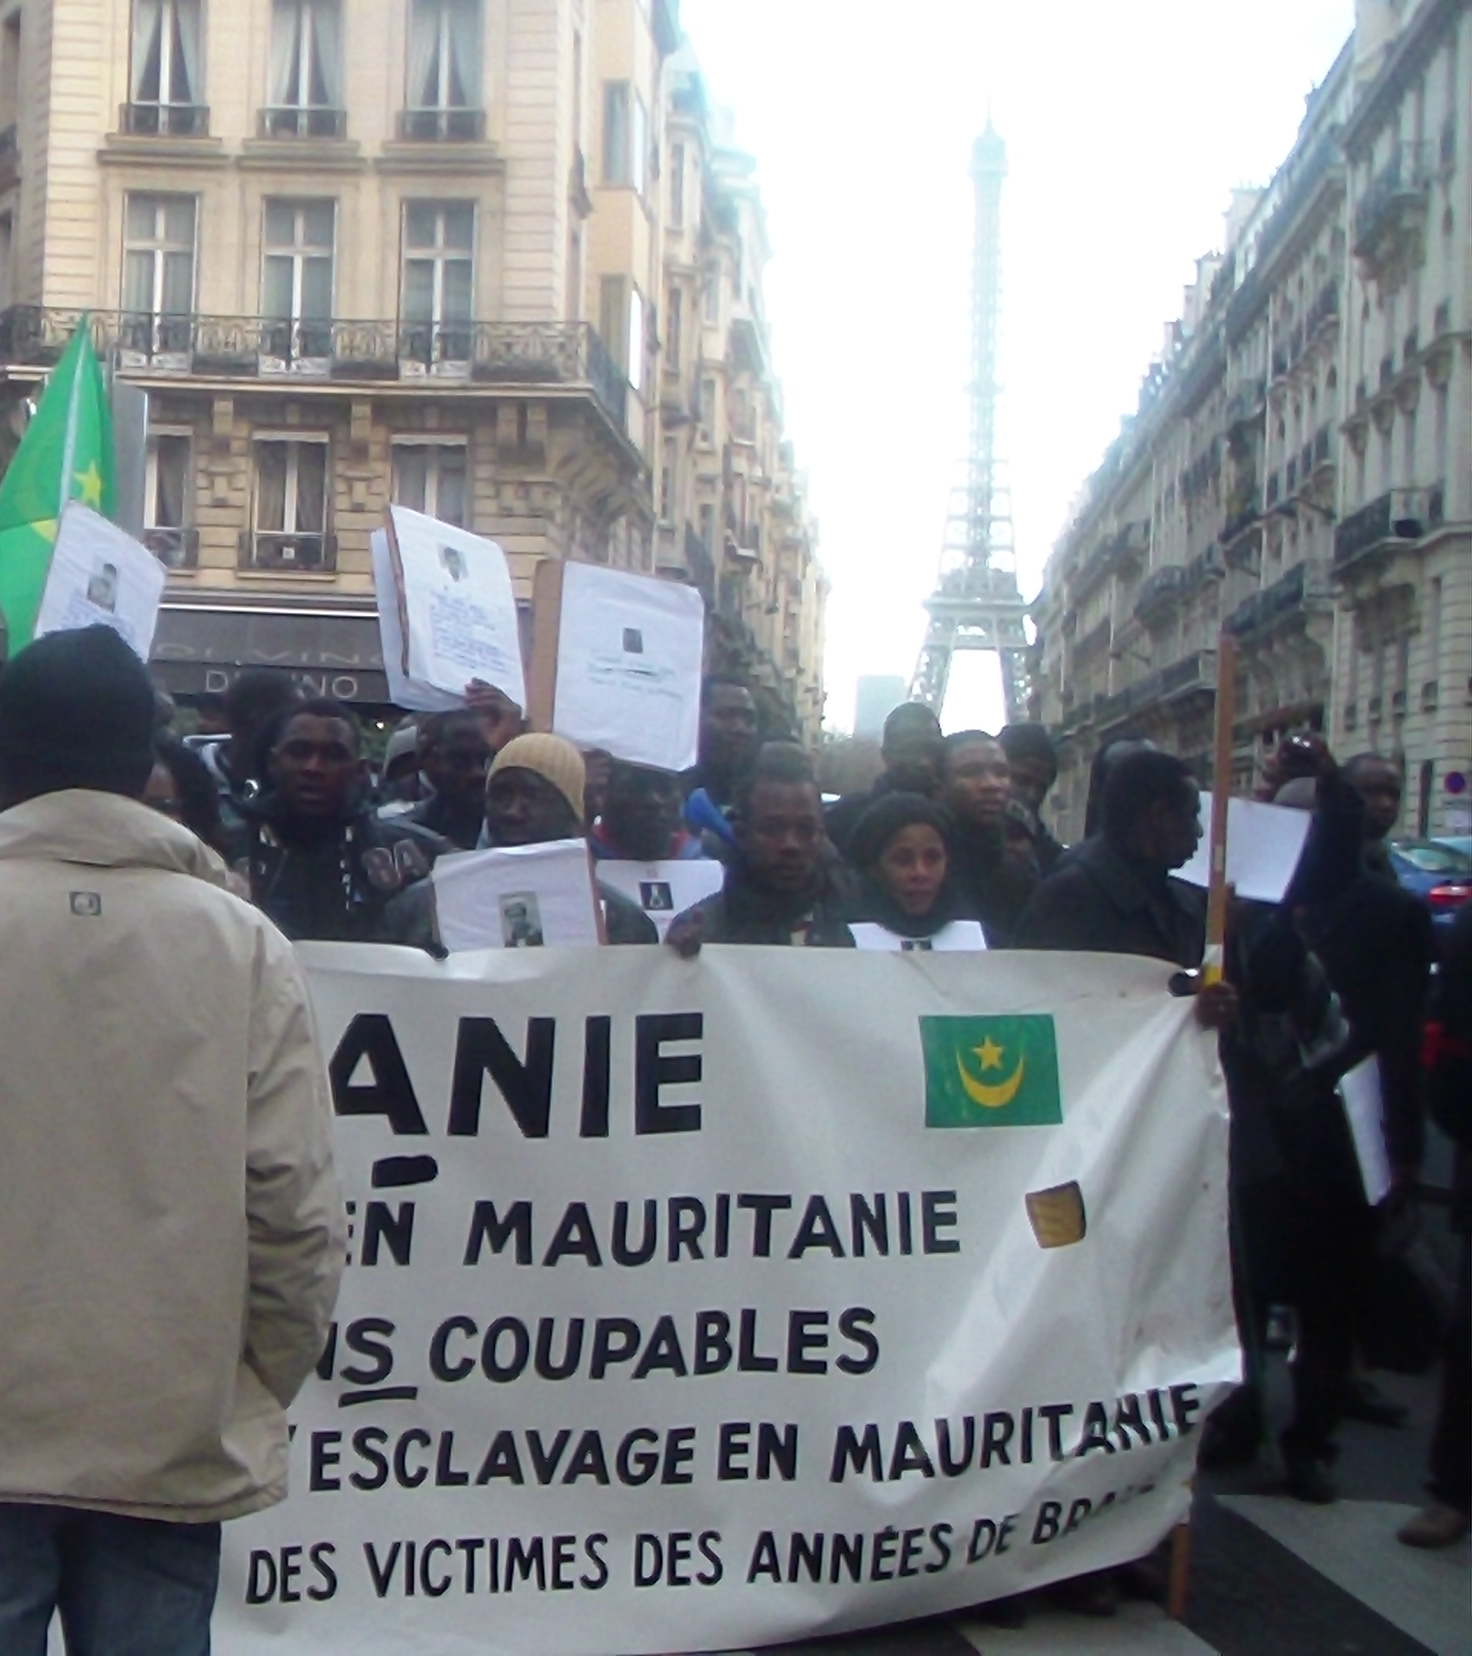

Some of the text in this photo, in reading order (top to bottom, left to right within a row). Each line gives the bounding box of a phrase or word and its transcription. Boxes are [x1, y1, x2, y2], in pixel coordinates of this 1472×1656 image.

[462, 1189, 960, 1266] MAURITANIE
[429, 1307, 880, 1383] COUPABLES
[718, 1423, 798, 1482] EN
[830, 1383, 1200, 1484] MAURITANIE
[245, 1542, 337, 1604] DES
[363, 1533, 608, 1598] VICTIMES
[633, 1528, 723, 1588] DES
[746, 1522, 952, 1585] ANNÉES
[967, 1513, 1020, 1564] DE
